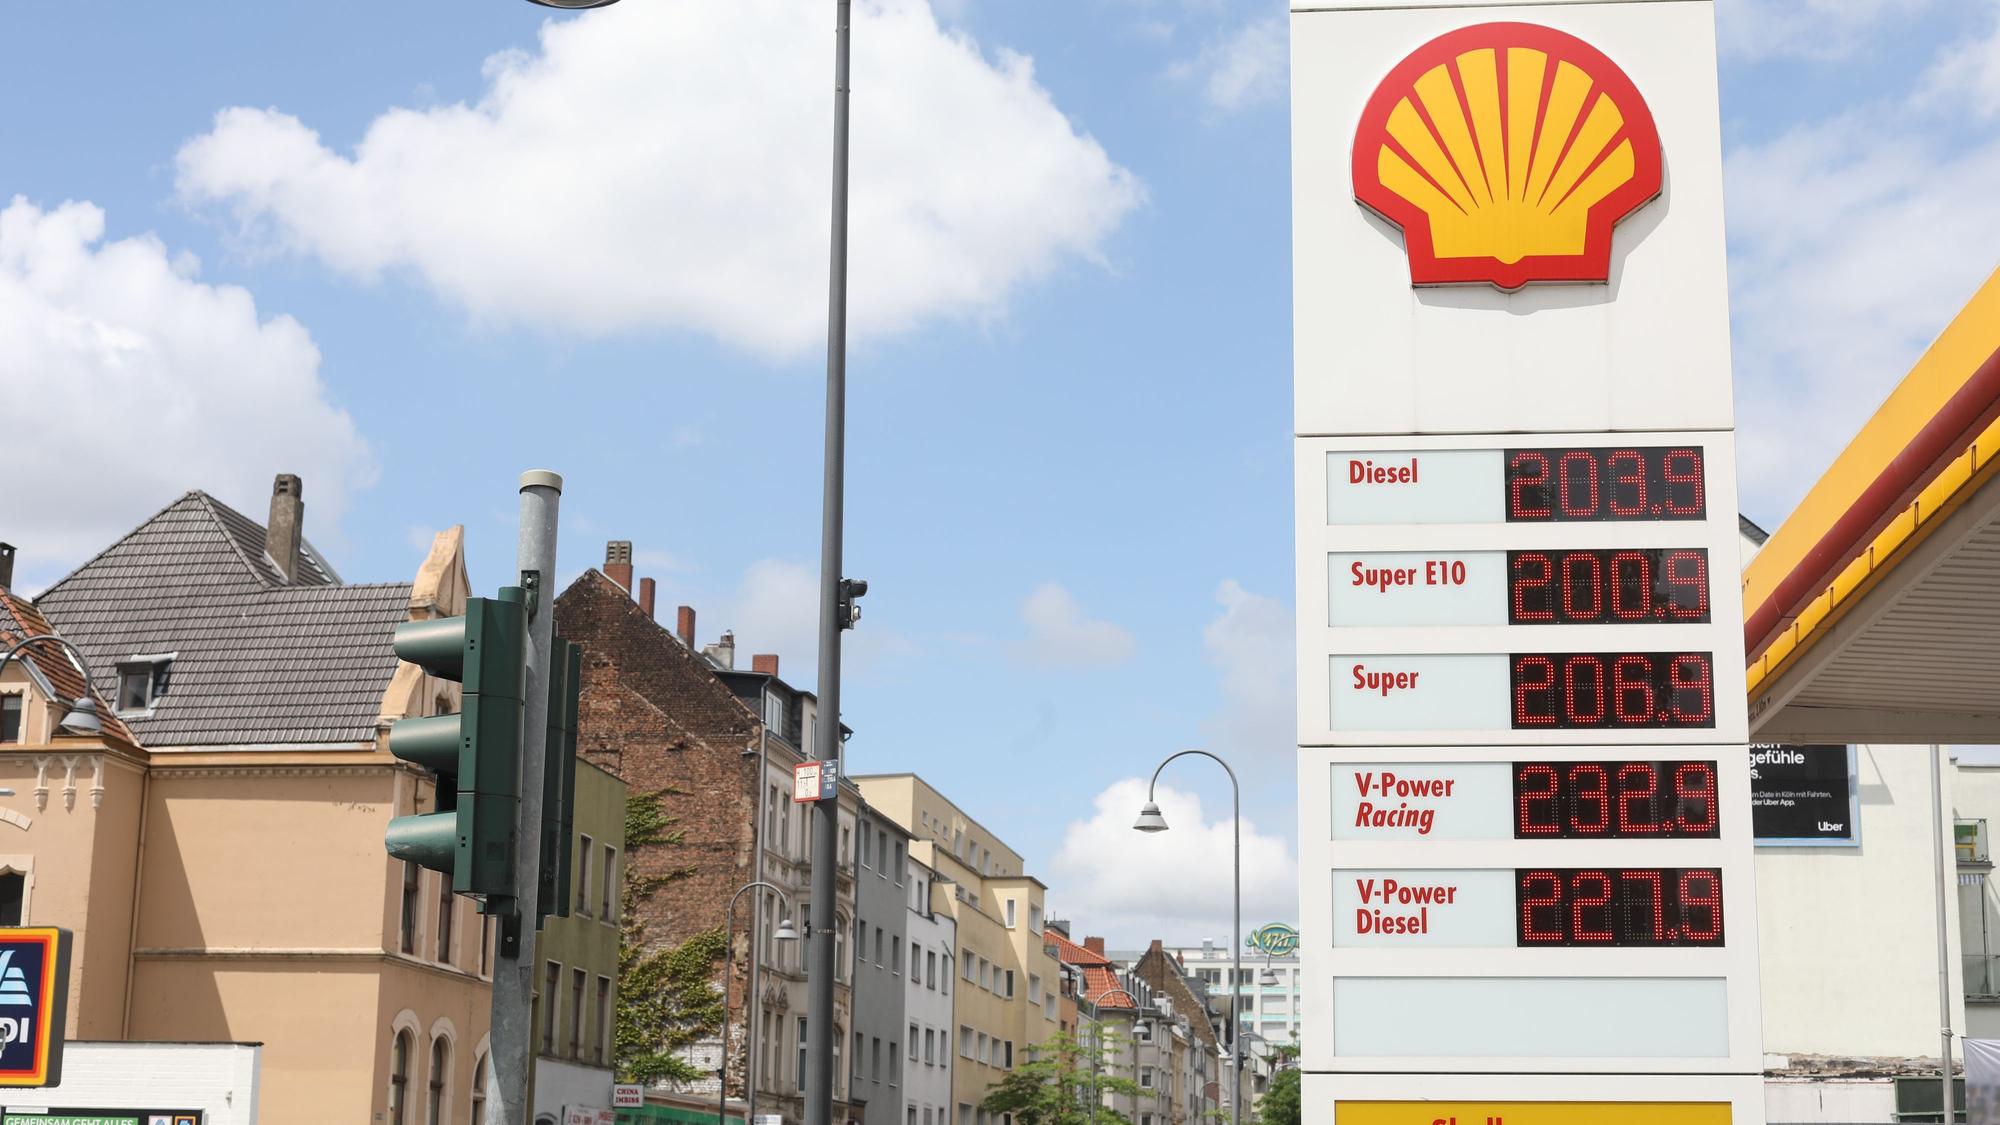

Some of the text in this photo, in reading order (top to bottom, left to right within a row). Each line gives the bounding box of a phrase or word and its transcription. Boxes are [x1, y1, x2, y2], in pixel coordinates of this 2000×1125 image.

[1349, 459, 1418, 485] Diesel
[1511, 450, 1702, 518] 203.9
[1351, 560, 1466, 593] Super E10
[1513, 551, 1707, 620] 200.9
[1353, 664, 1419, 696] Super
[1516, 655, 1712, 724] 206.9
[1355, 772, 1455, 798] V-Power
[1519, 763, 1717, 833] 232.9
[1355, 801, 1435, 836] Racing
[1818, 821, 1844, 832] Uber
[1356, 879, 1457, 905] V-Power
[1522, 871, 1721, 941] 227.9
[1356, 907, 1428, 935] Diesel
